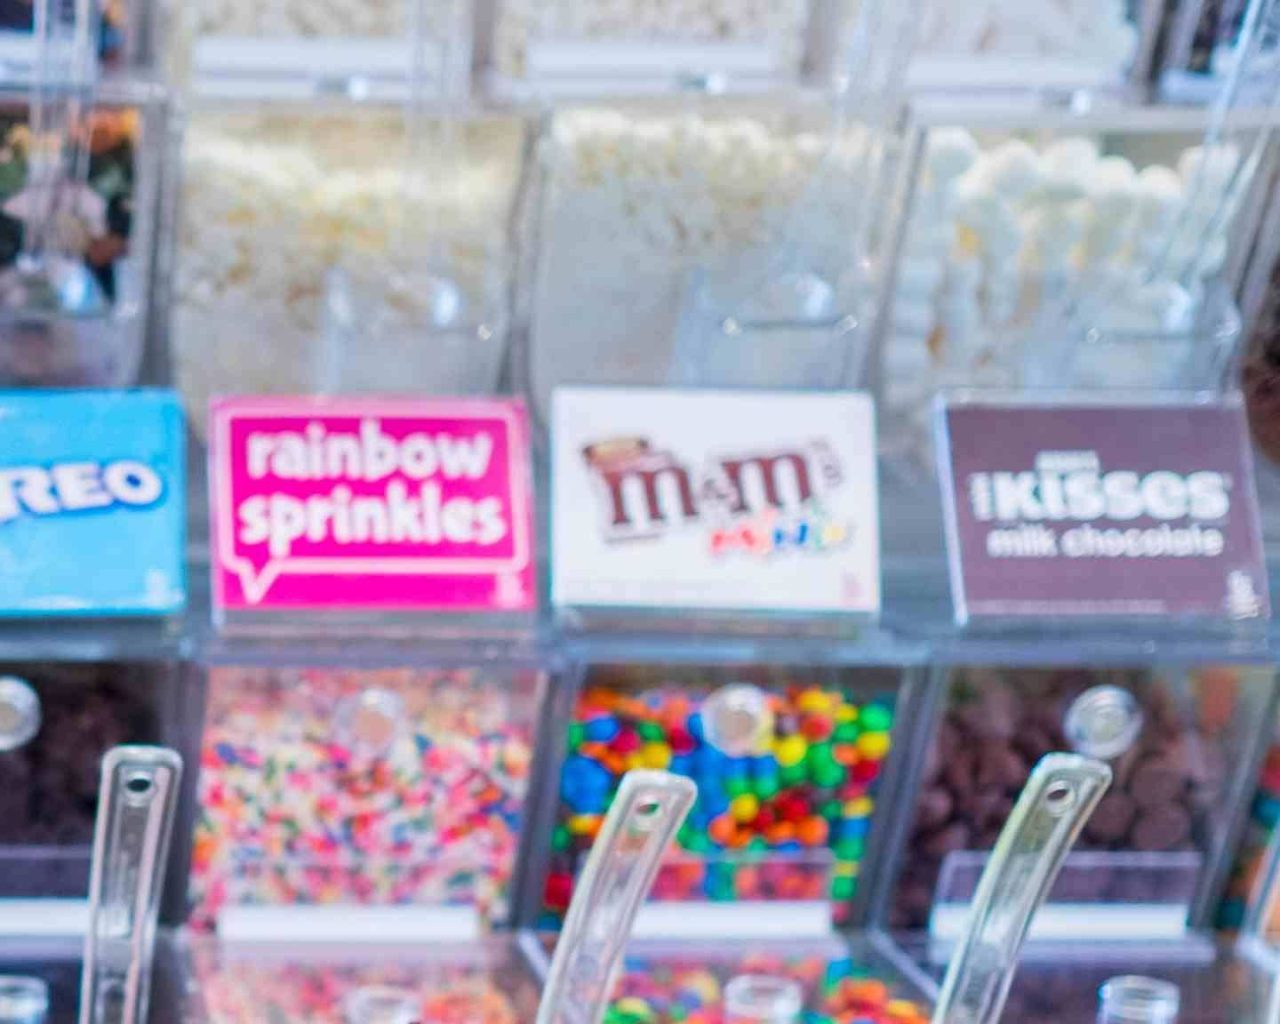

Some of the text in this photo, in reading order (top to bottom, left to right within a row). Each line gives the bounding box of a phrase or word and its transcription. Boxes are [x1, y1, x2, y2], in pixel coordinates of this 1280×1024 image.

[245, 417, 492, 481] rainbow
[238, 479, 507, 556] sprinkles
[985, 521, 1224, 558] milk chocolate
